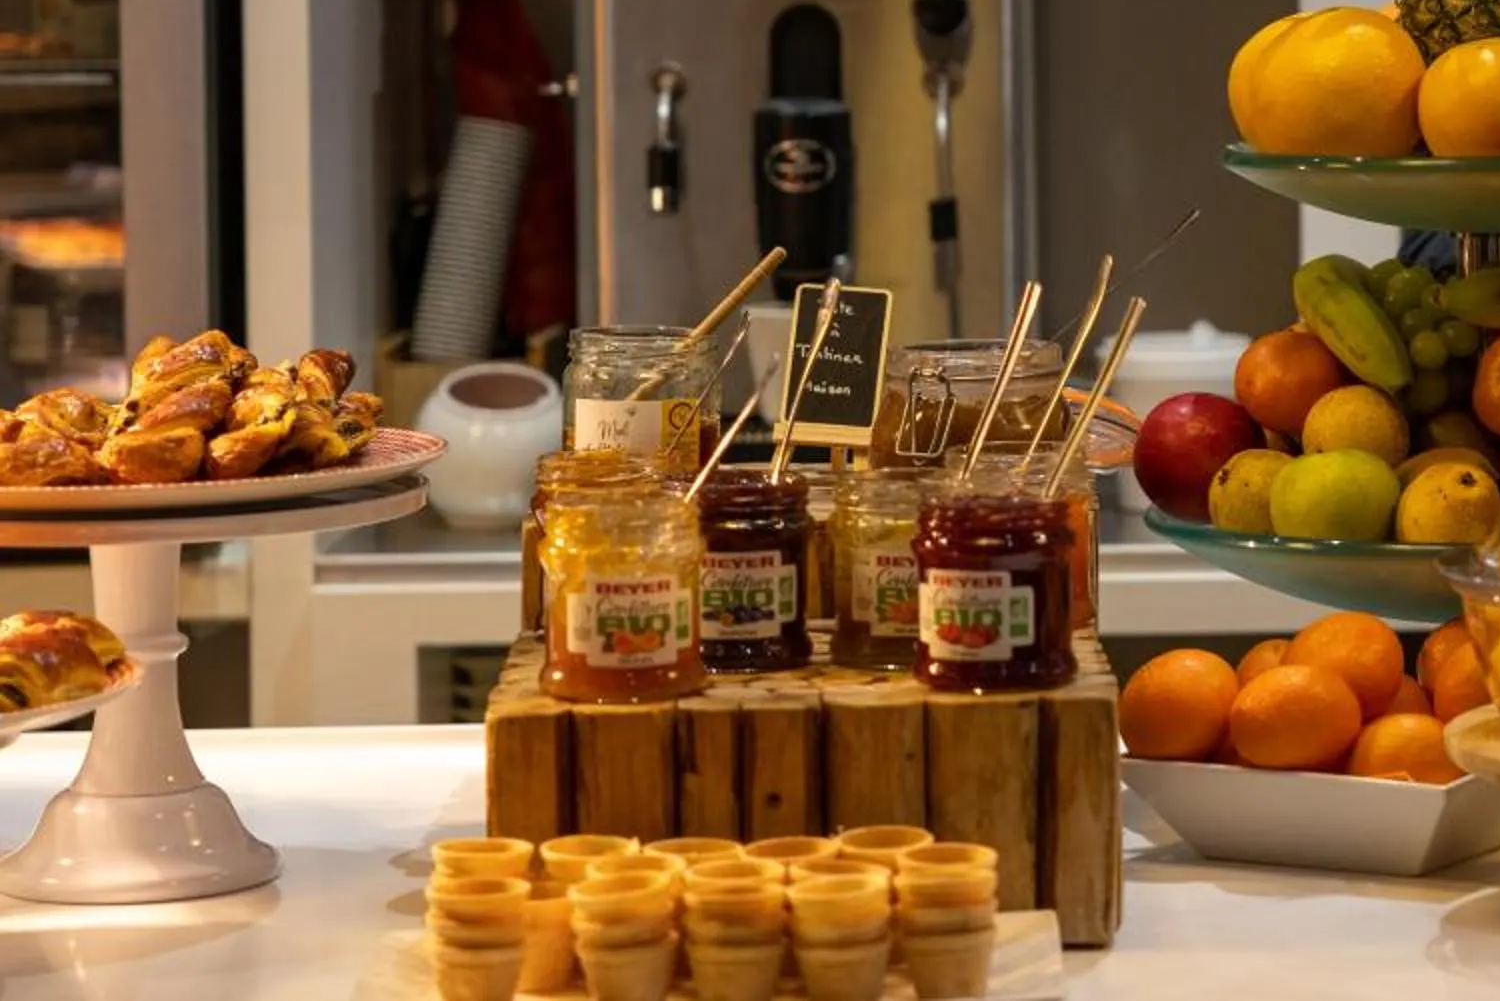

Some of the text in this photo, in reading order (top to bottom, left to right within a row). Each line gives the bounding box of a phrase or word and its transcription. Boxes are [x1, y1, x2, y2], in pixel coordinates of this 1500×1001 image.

[595, 580, 671, 595] BEYER
[703, 589, 774, 608] BIO
[597, 614, 671, 636] BIO
[933, 607, 1003, 628] BIO
